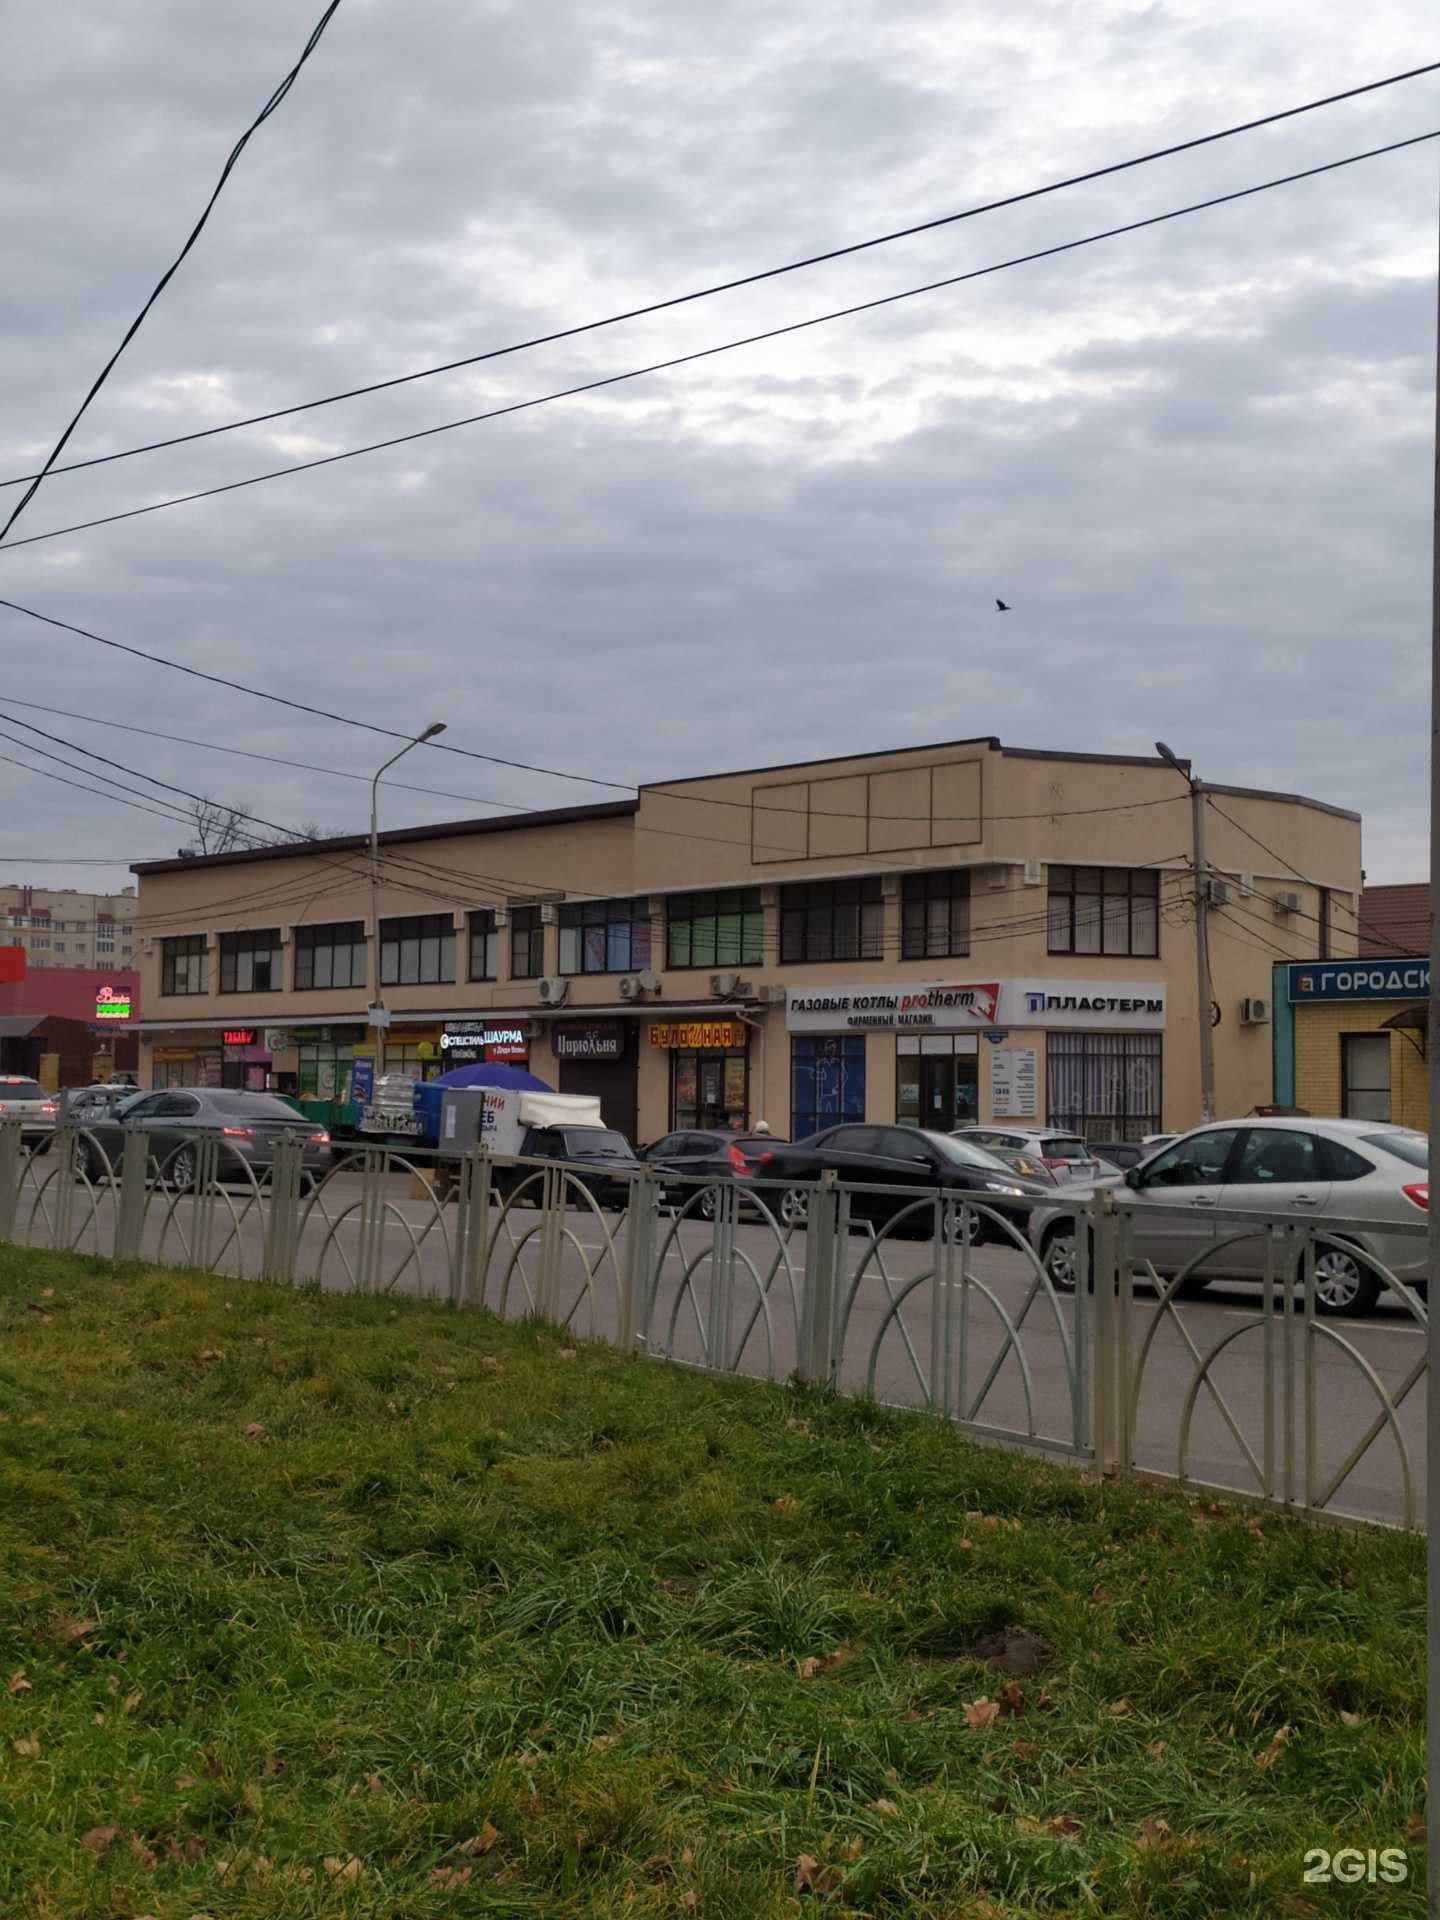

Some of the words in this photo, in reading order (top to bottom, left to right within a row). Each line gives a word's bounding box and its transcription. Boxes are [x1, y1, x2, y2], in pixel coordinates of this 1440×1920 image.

[791, 998, 849, 1011] ГАЗОВЫЕ
[853, 995, 898, 1009] КОТЛЫ
[901, 990, 975, 1012] protherm
[1047, 997, 1162, 1012] ПЛАСТЕРМ
[847, 1015, 893, 1025] ФИРМЕННЫЙ
[484, 1030, 523, 1044] ШАУРМА
